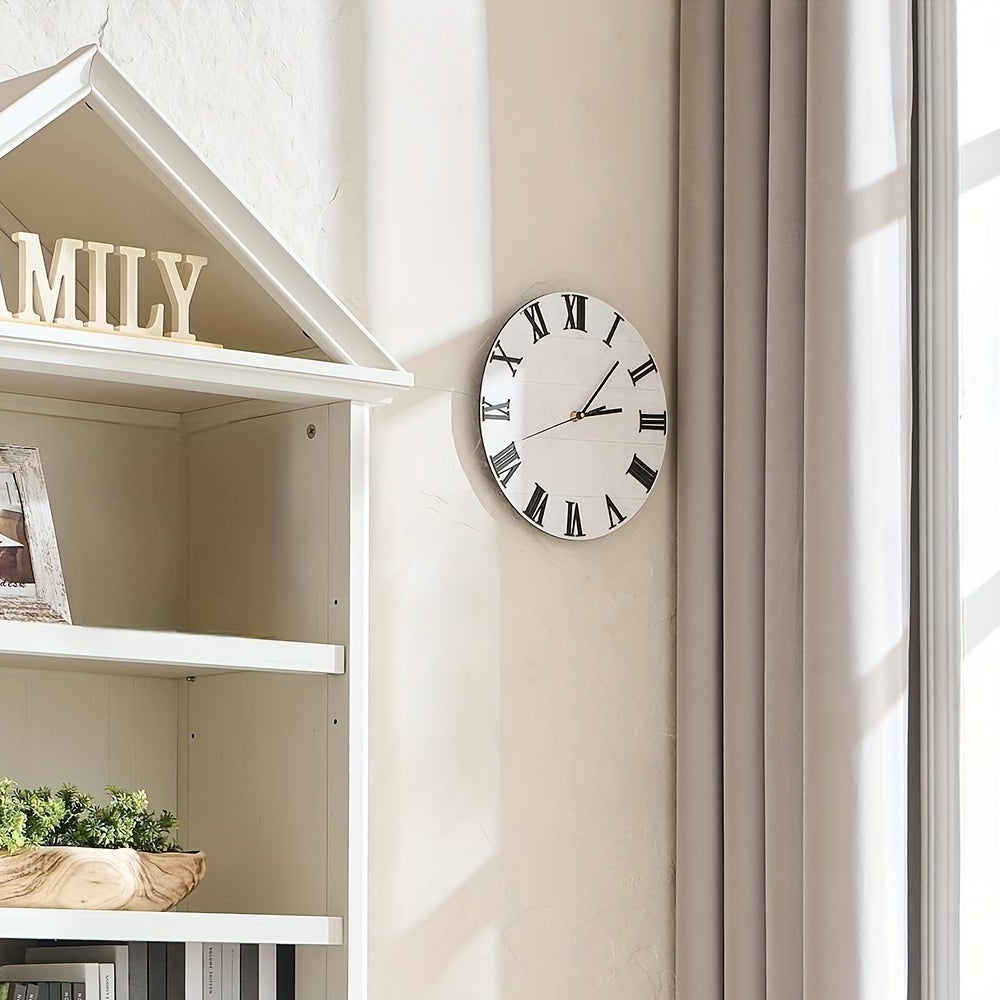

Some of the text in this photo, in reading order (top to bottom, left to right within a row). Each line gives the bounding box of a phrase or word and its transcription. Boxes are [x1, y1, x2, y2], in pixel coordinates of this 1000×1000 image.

[523, 301, 550, 344] XI
[489, 340, 523, 377] X
[627, 354, 658, 386] II
[482, 396, 510, 421] IX
[639, 410, 666, 435] III
[564, 501, 586, 537] VI
[604, 494, 627, 530] V
